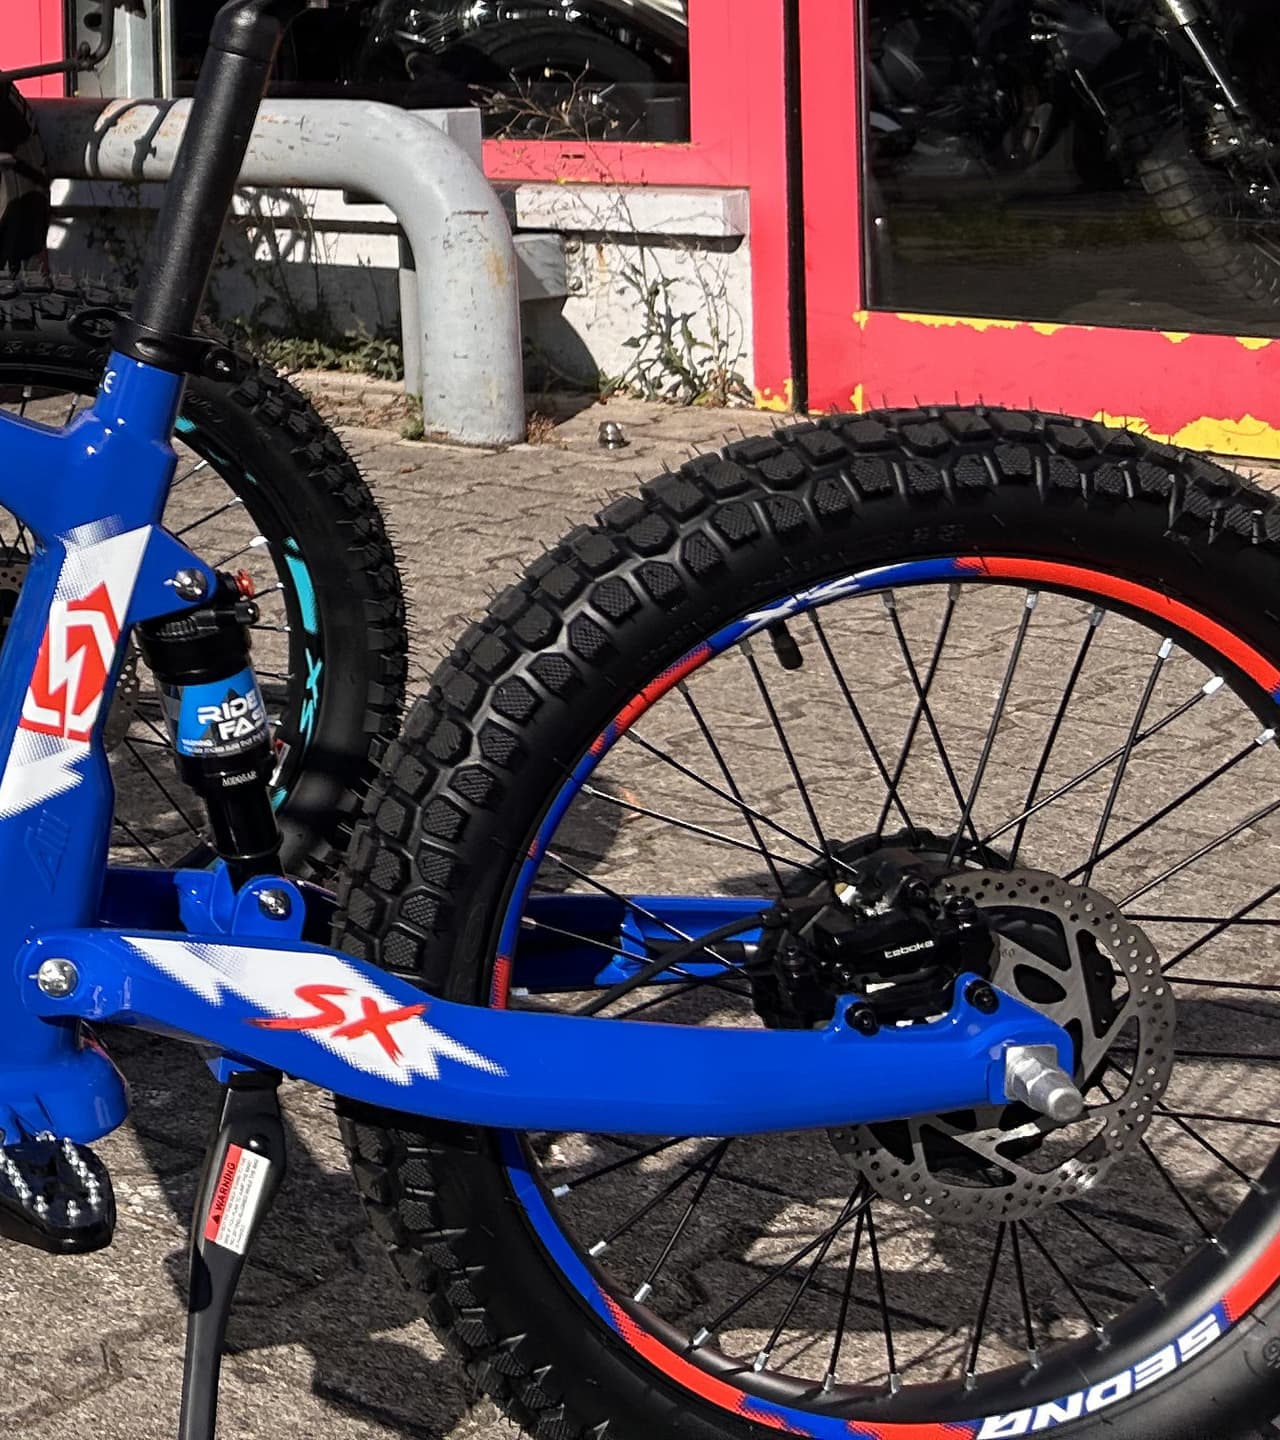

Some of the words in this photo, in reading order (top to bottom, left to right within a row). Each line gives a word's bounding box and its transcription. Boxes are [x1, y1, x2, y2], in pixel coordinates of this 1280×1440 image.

[197, 688, 259, 725] RIDE
[249, 984, 427, 1064] SX
[976, 1313, 1221, 1440] SEDNA
